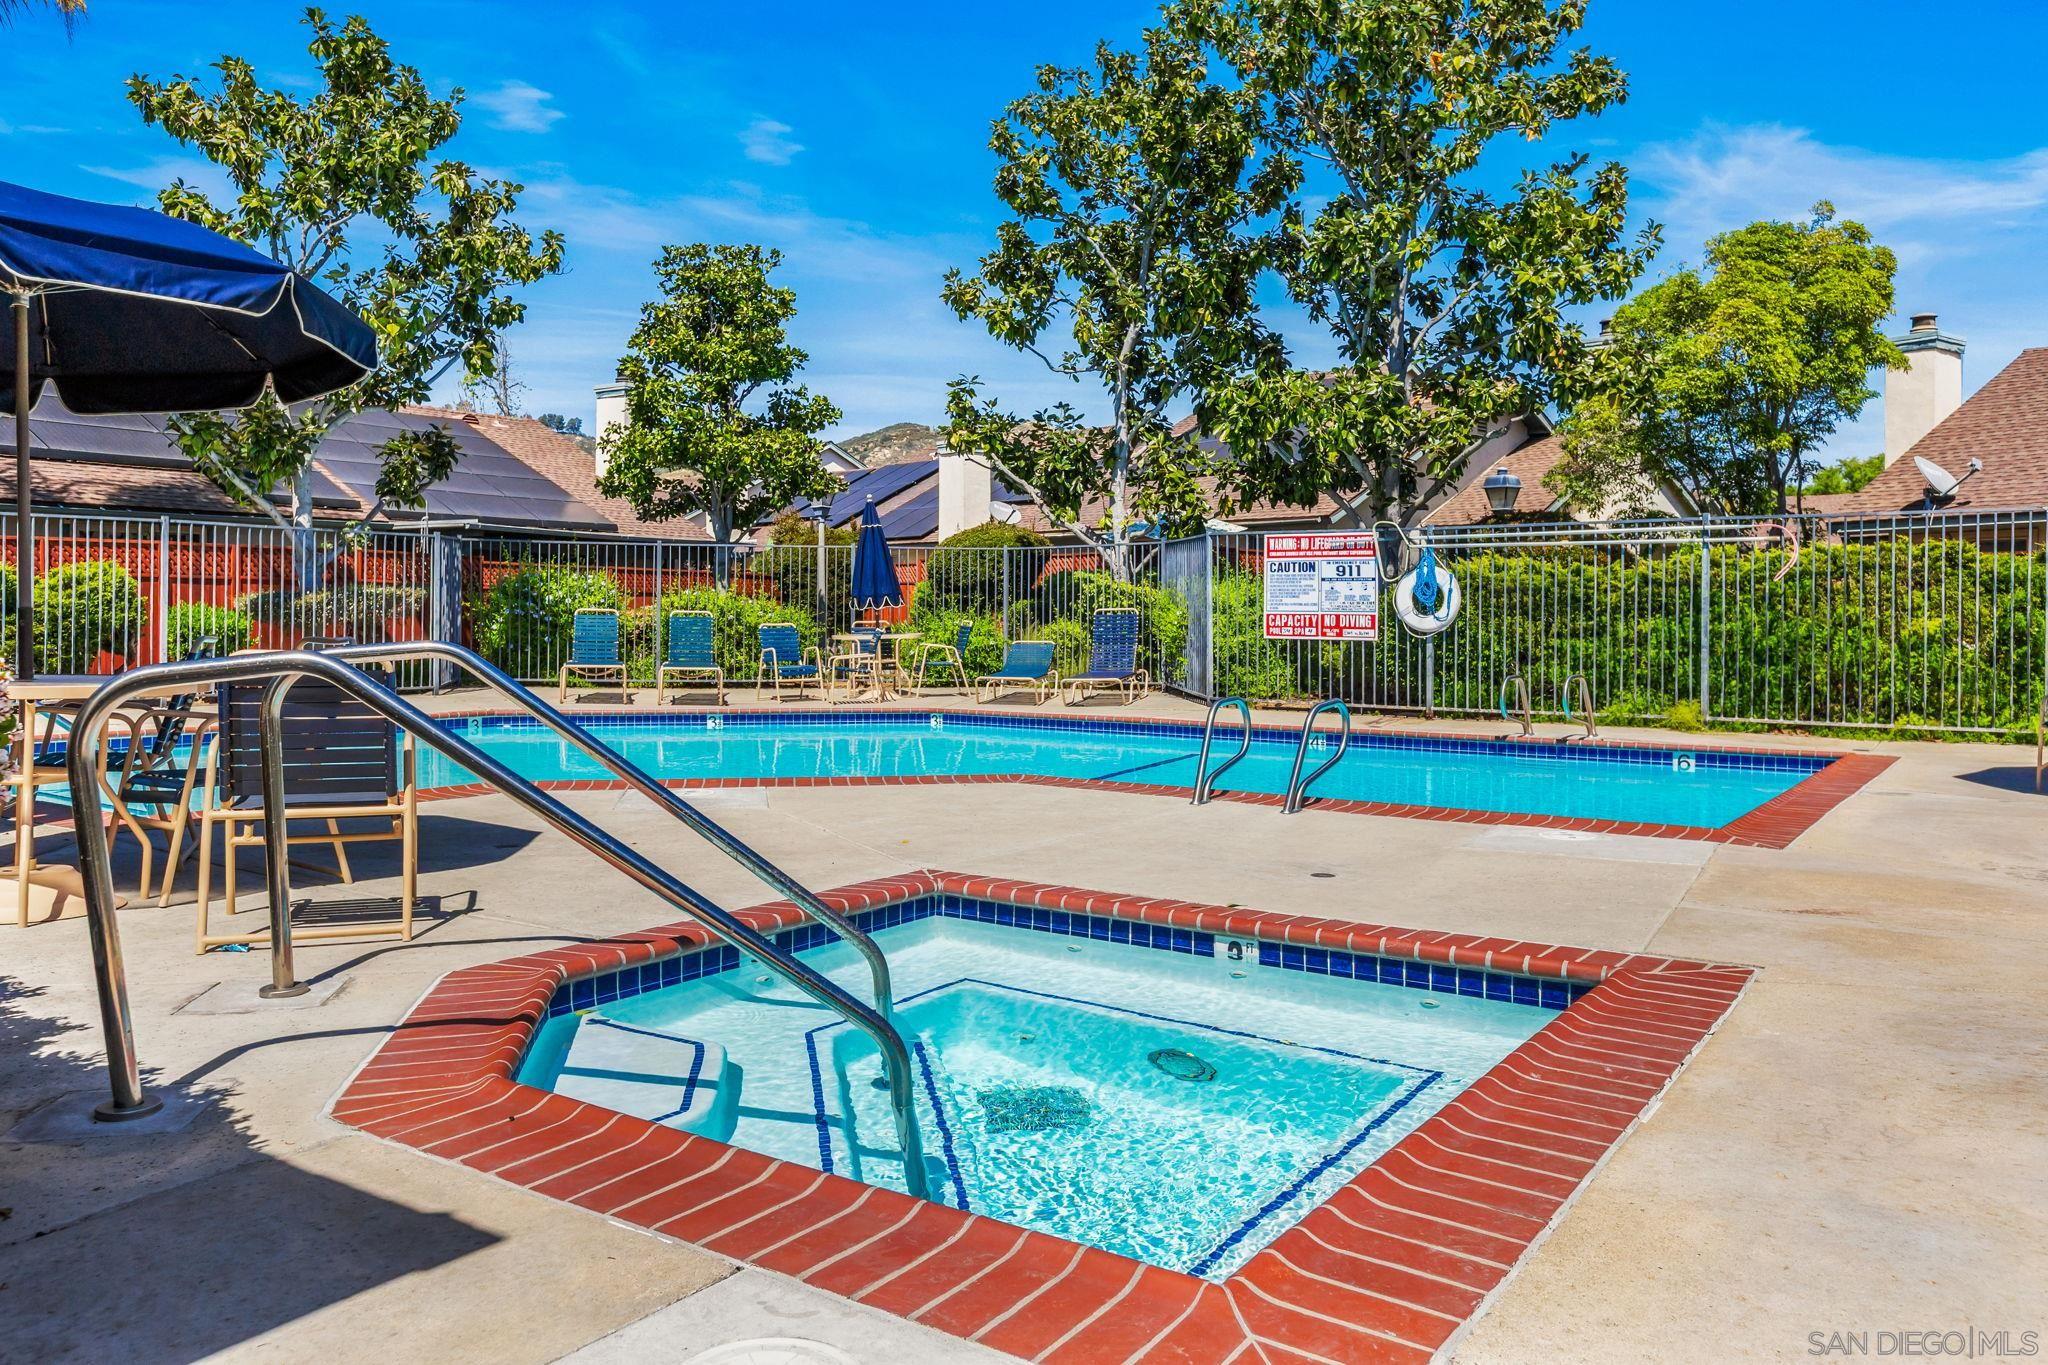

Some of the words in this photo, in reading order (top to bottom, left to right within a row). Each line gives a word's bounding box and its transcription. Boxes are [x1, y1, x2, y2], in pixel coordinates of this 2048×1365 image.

[1300, 537, 1310, 550] NO
[1311, 537, 1344, 550] LIFEGUARD
[1346, 536, 1355, 549] ON
[1356, 536, 1374, 549] DUTY
[1269, 561, 1316, 573] CAUTION
[1335, 564, 1361, 577] 911
[1268, 614, 1318, 627] CAPACITY
[1323, 614, 1337, 627] NO
[1340, 614, 1372, 628] DIVING
[1293, 627, 1305, 635] SPA
[1677, 754, 1691, 771] 6
